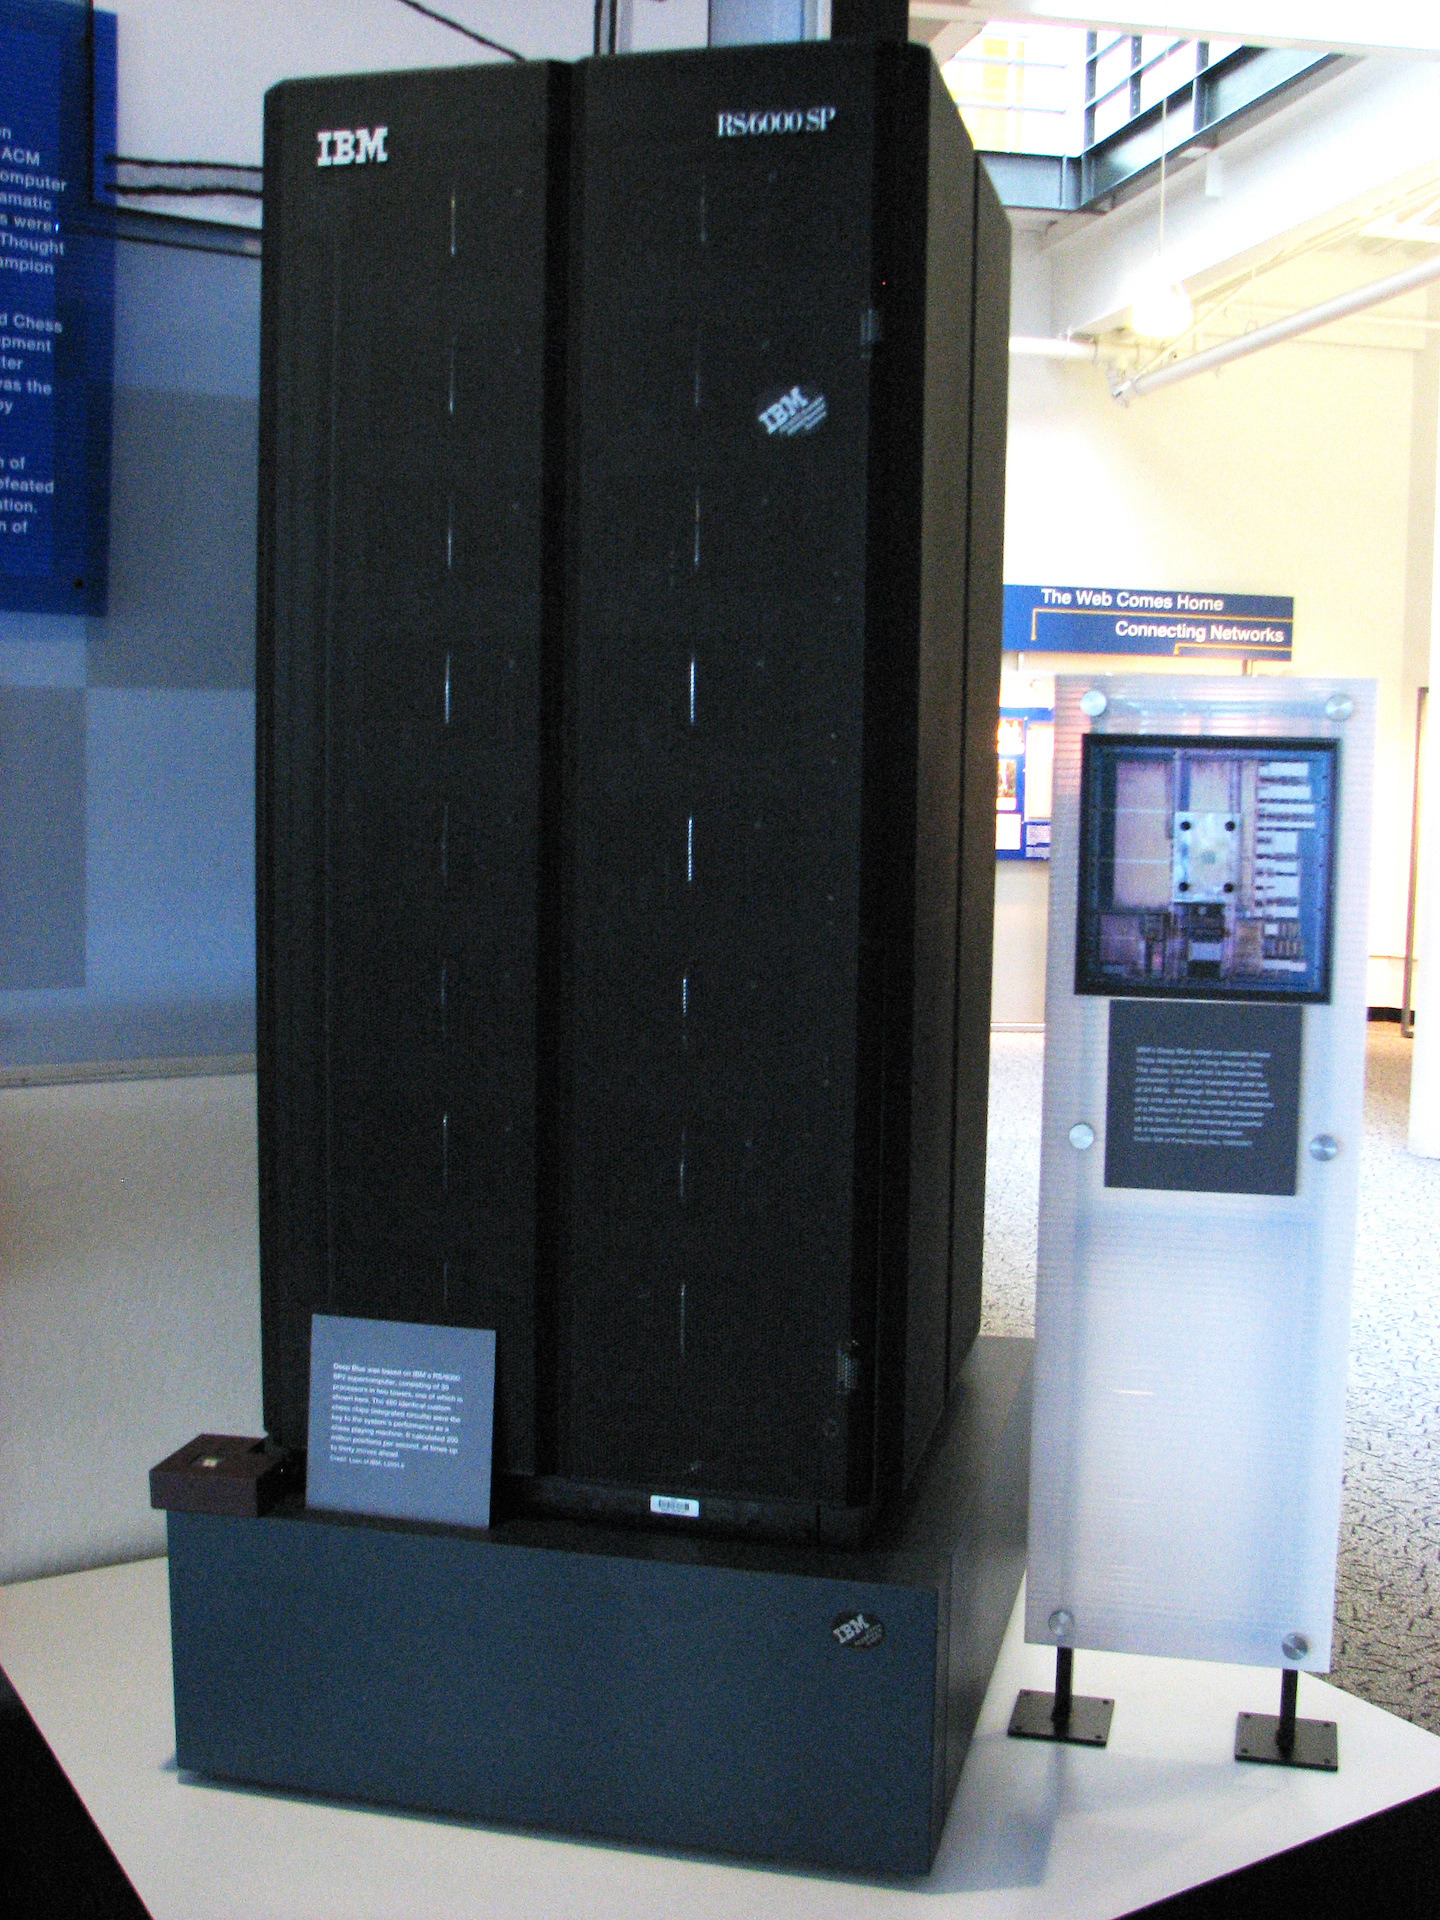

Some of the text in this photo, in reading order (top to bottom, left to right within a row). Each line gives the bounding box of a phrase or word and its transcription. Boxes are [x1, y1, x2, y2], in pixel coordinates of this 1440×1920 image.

[806, 105, 836, 132] SP
[2, 146, 41, 167] ACM
[317, 127, 388, 167] IBM
[14, 216, 52, 233] were
[0, 231, 65, 256] Thought
[14, 314, 63, 334] Chess
[27, 379, 52, 396] the
[758, 385, 808, 434] IBM
[9, 457, 26, 470] of
[12, 520, 28, 535] of
[1041, 588, 1224, 611] The Web Comes Home
[1115, 620, 1285, 643] Connecting Networks
[833, 1614, 870, 1643] IBM
